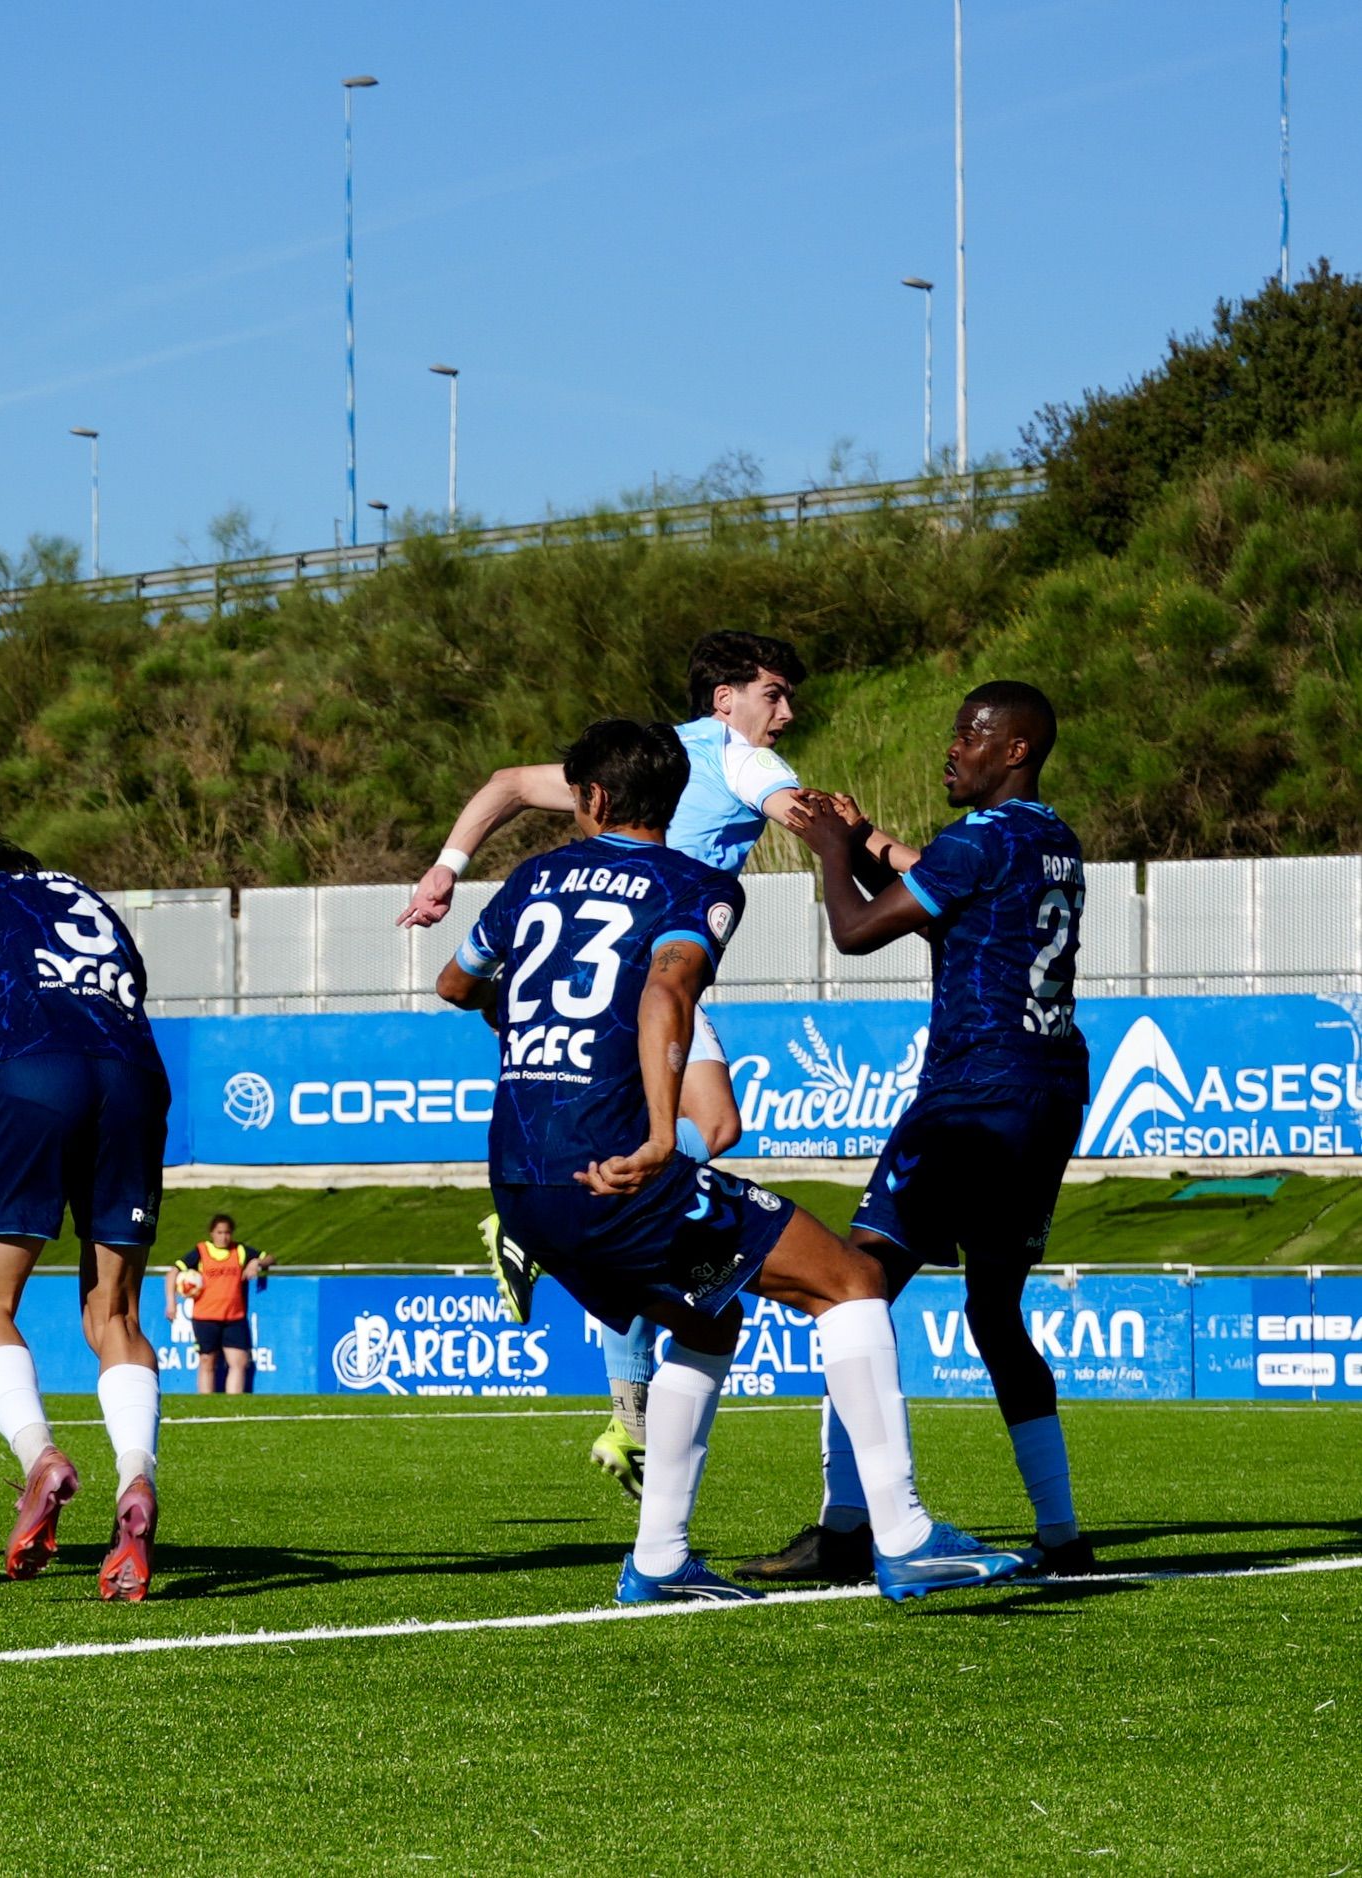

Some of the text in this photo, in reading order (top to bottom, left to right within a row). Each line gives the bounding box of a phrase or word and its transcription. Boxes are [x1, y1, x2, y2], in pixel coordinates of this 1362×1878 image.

[530, 868, 651, 899] J. ALGAR
[46, 881, 118, 955] 3
[508, 899, 634, 1023] 23
[1118, 1118, 1283, 1158] ASESORÍA
[1289, 1126, 1354, 1156] DEL
[353, 1315, 551, 1378] PAREDES
